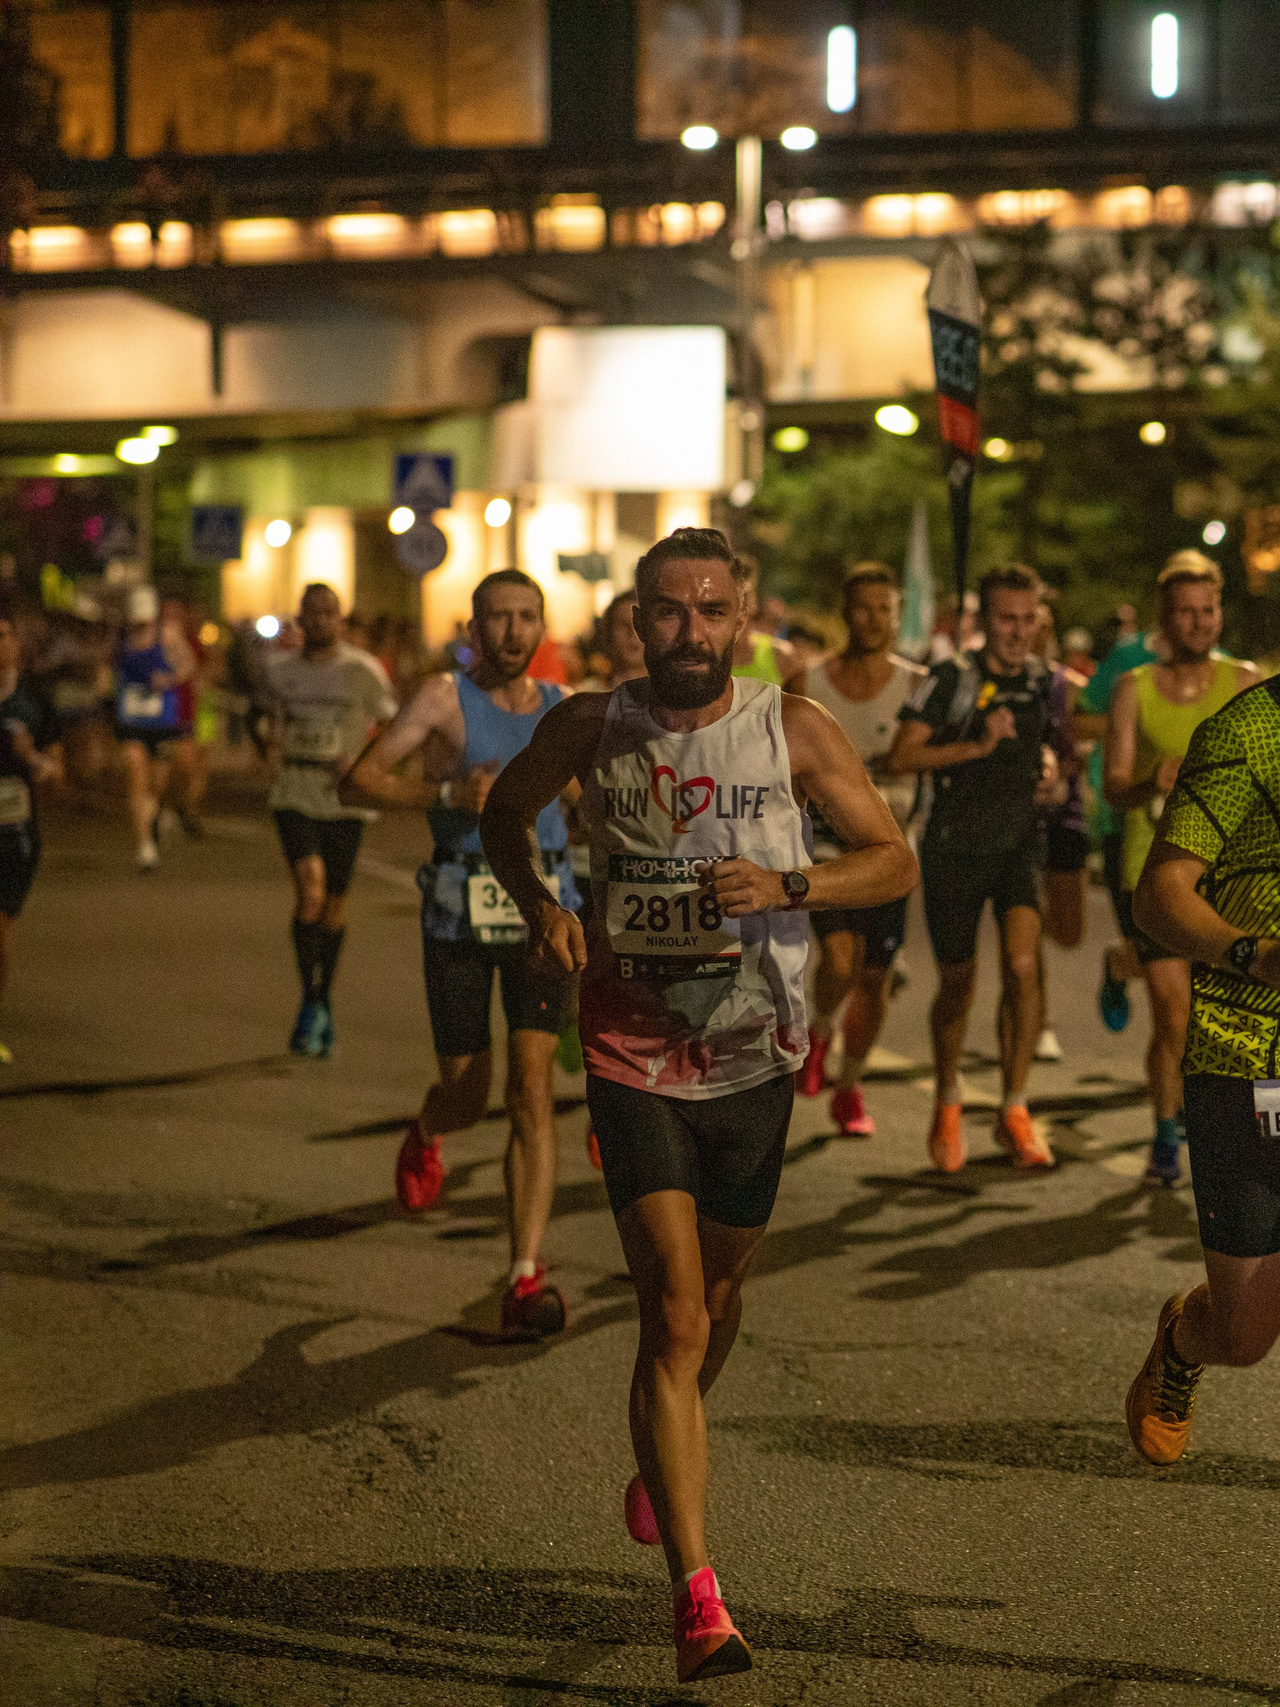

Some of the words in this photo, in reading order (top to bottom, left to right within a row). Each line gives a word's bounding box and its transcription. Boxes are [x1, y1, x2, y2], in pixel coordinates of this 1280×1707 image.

[604, 787, 649, 818] RUN
[671, 786, 695, 822] IS
[716, 785, 769, 819] LIFE
[623, 894, 722, 932] 2818
[646, 936, 698, 947] NIKOLAY
[620, 959, 634, 979] B
